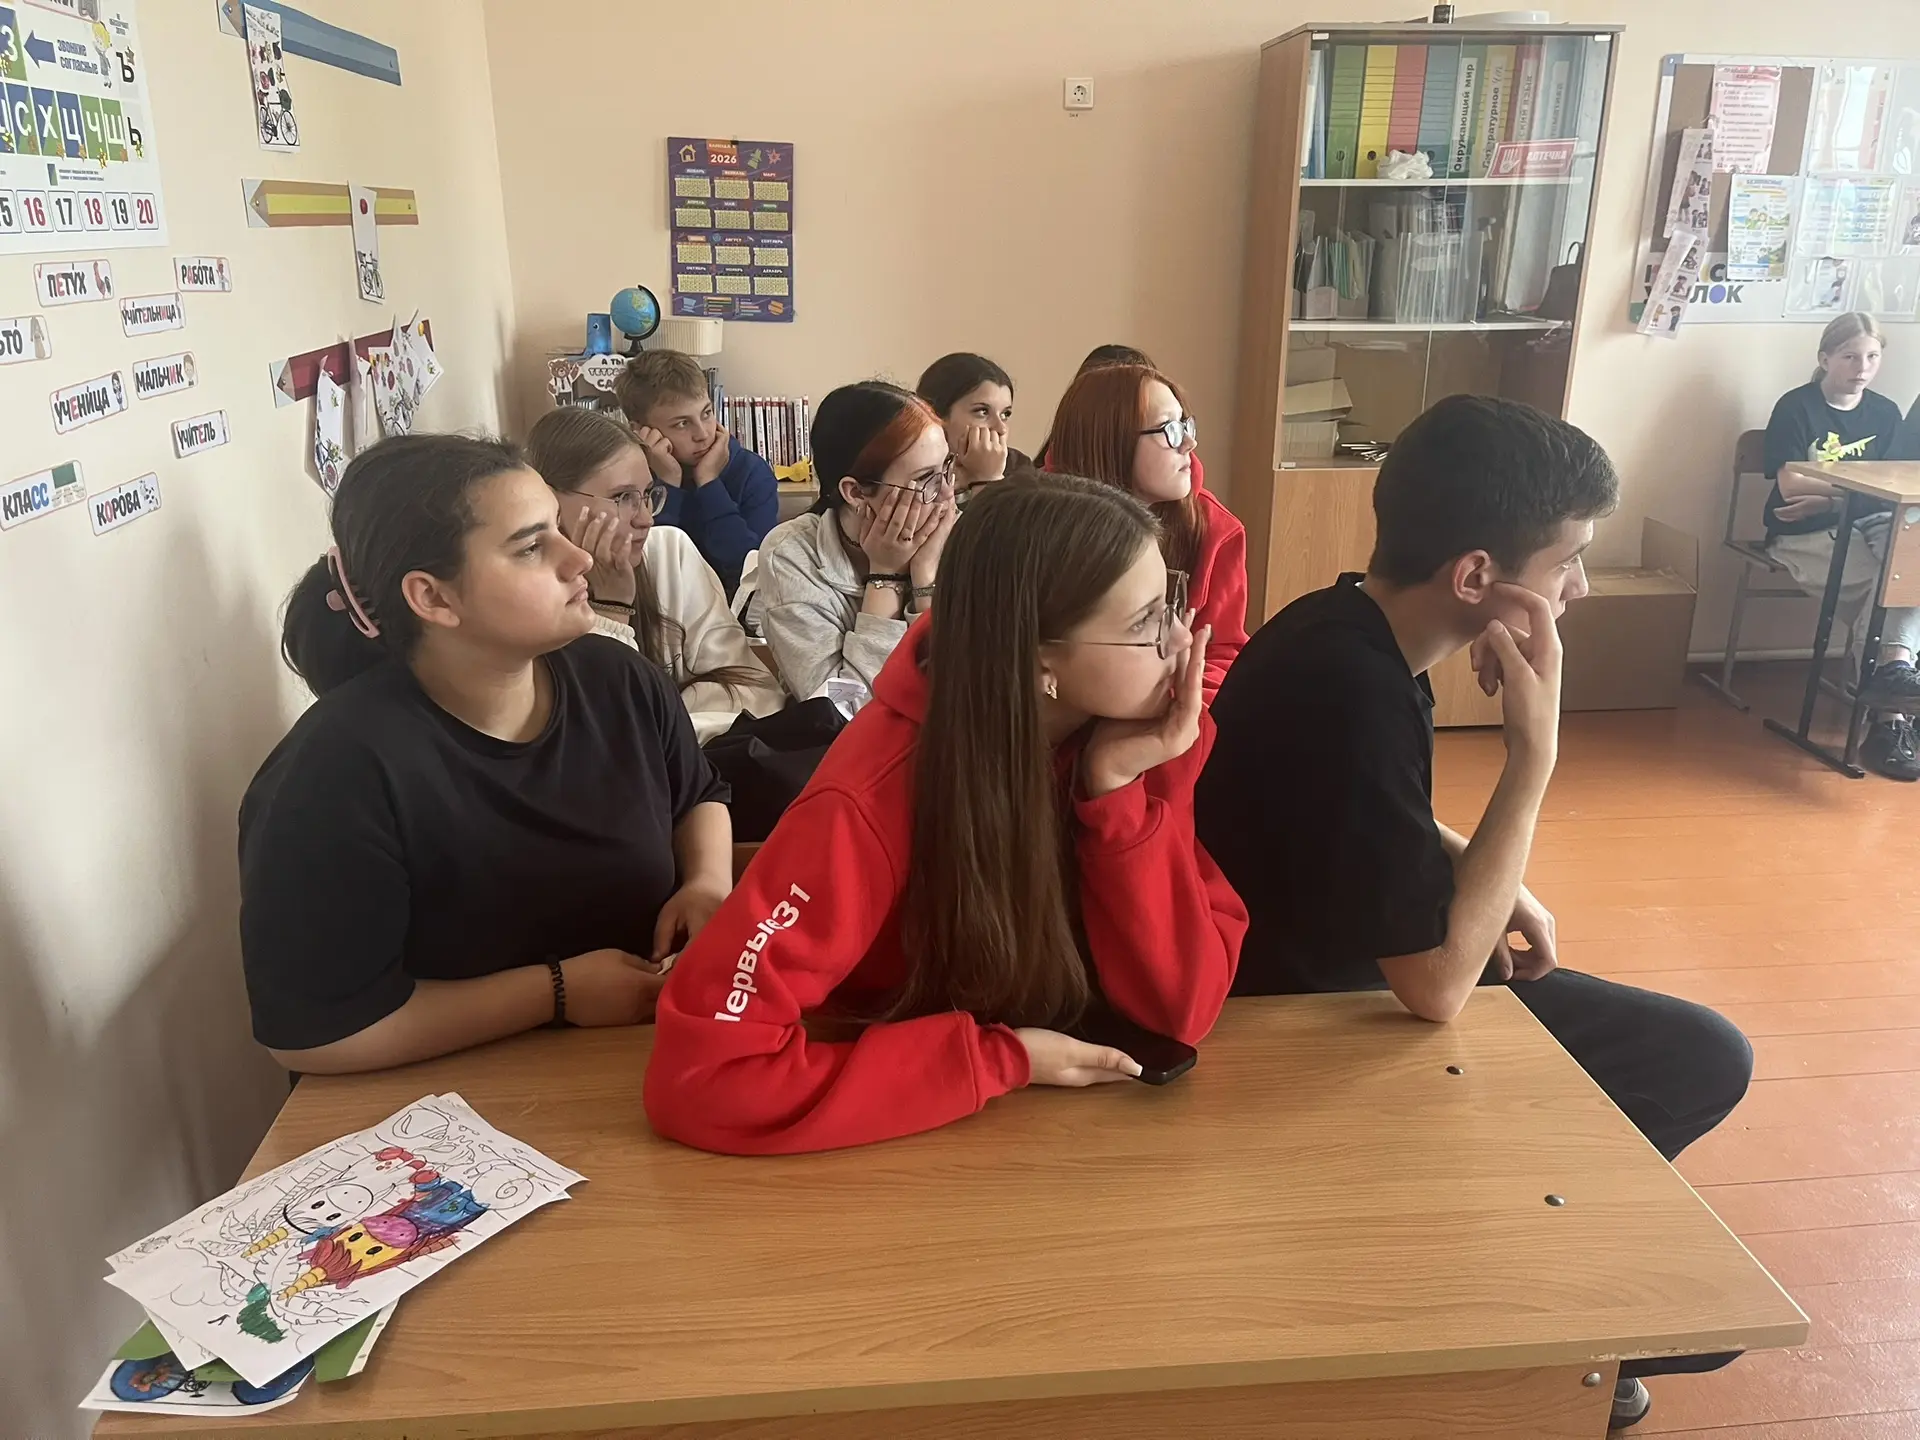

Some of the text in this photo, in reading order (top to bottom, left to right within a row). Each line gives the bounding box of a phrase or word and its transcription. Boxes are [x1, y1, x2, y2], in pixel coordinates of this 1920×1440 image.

[1453, 64, 1475, 172] Окружающий мир
[711, 154, 737, 163] 2026
[24, 197, 46, 226] 16
[55, 198, 73, 225] 17
[84, 198, 103, 225] 18
[112, 198, 129, 224] 19
[137, 198, 154, 224] 20
[3, 482, 49, 521] КЛАСС
